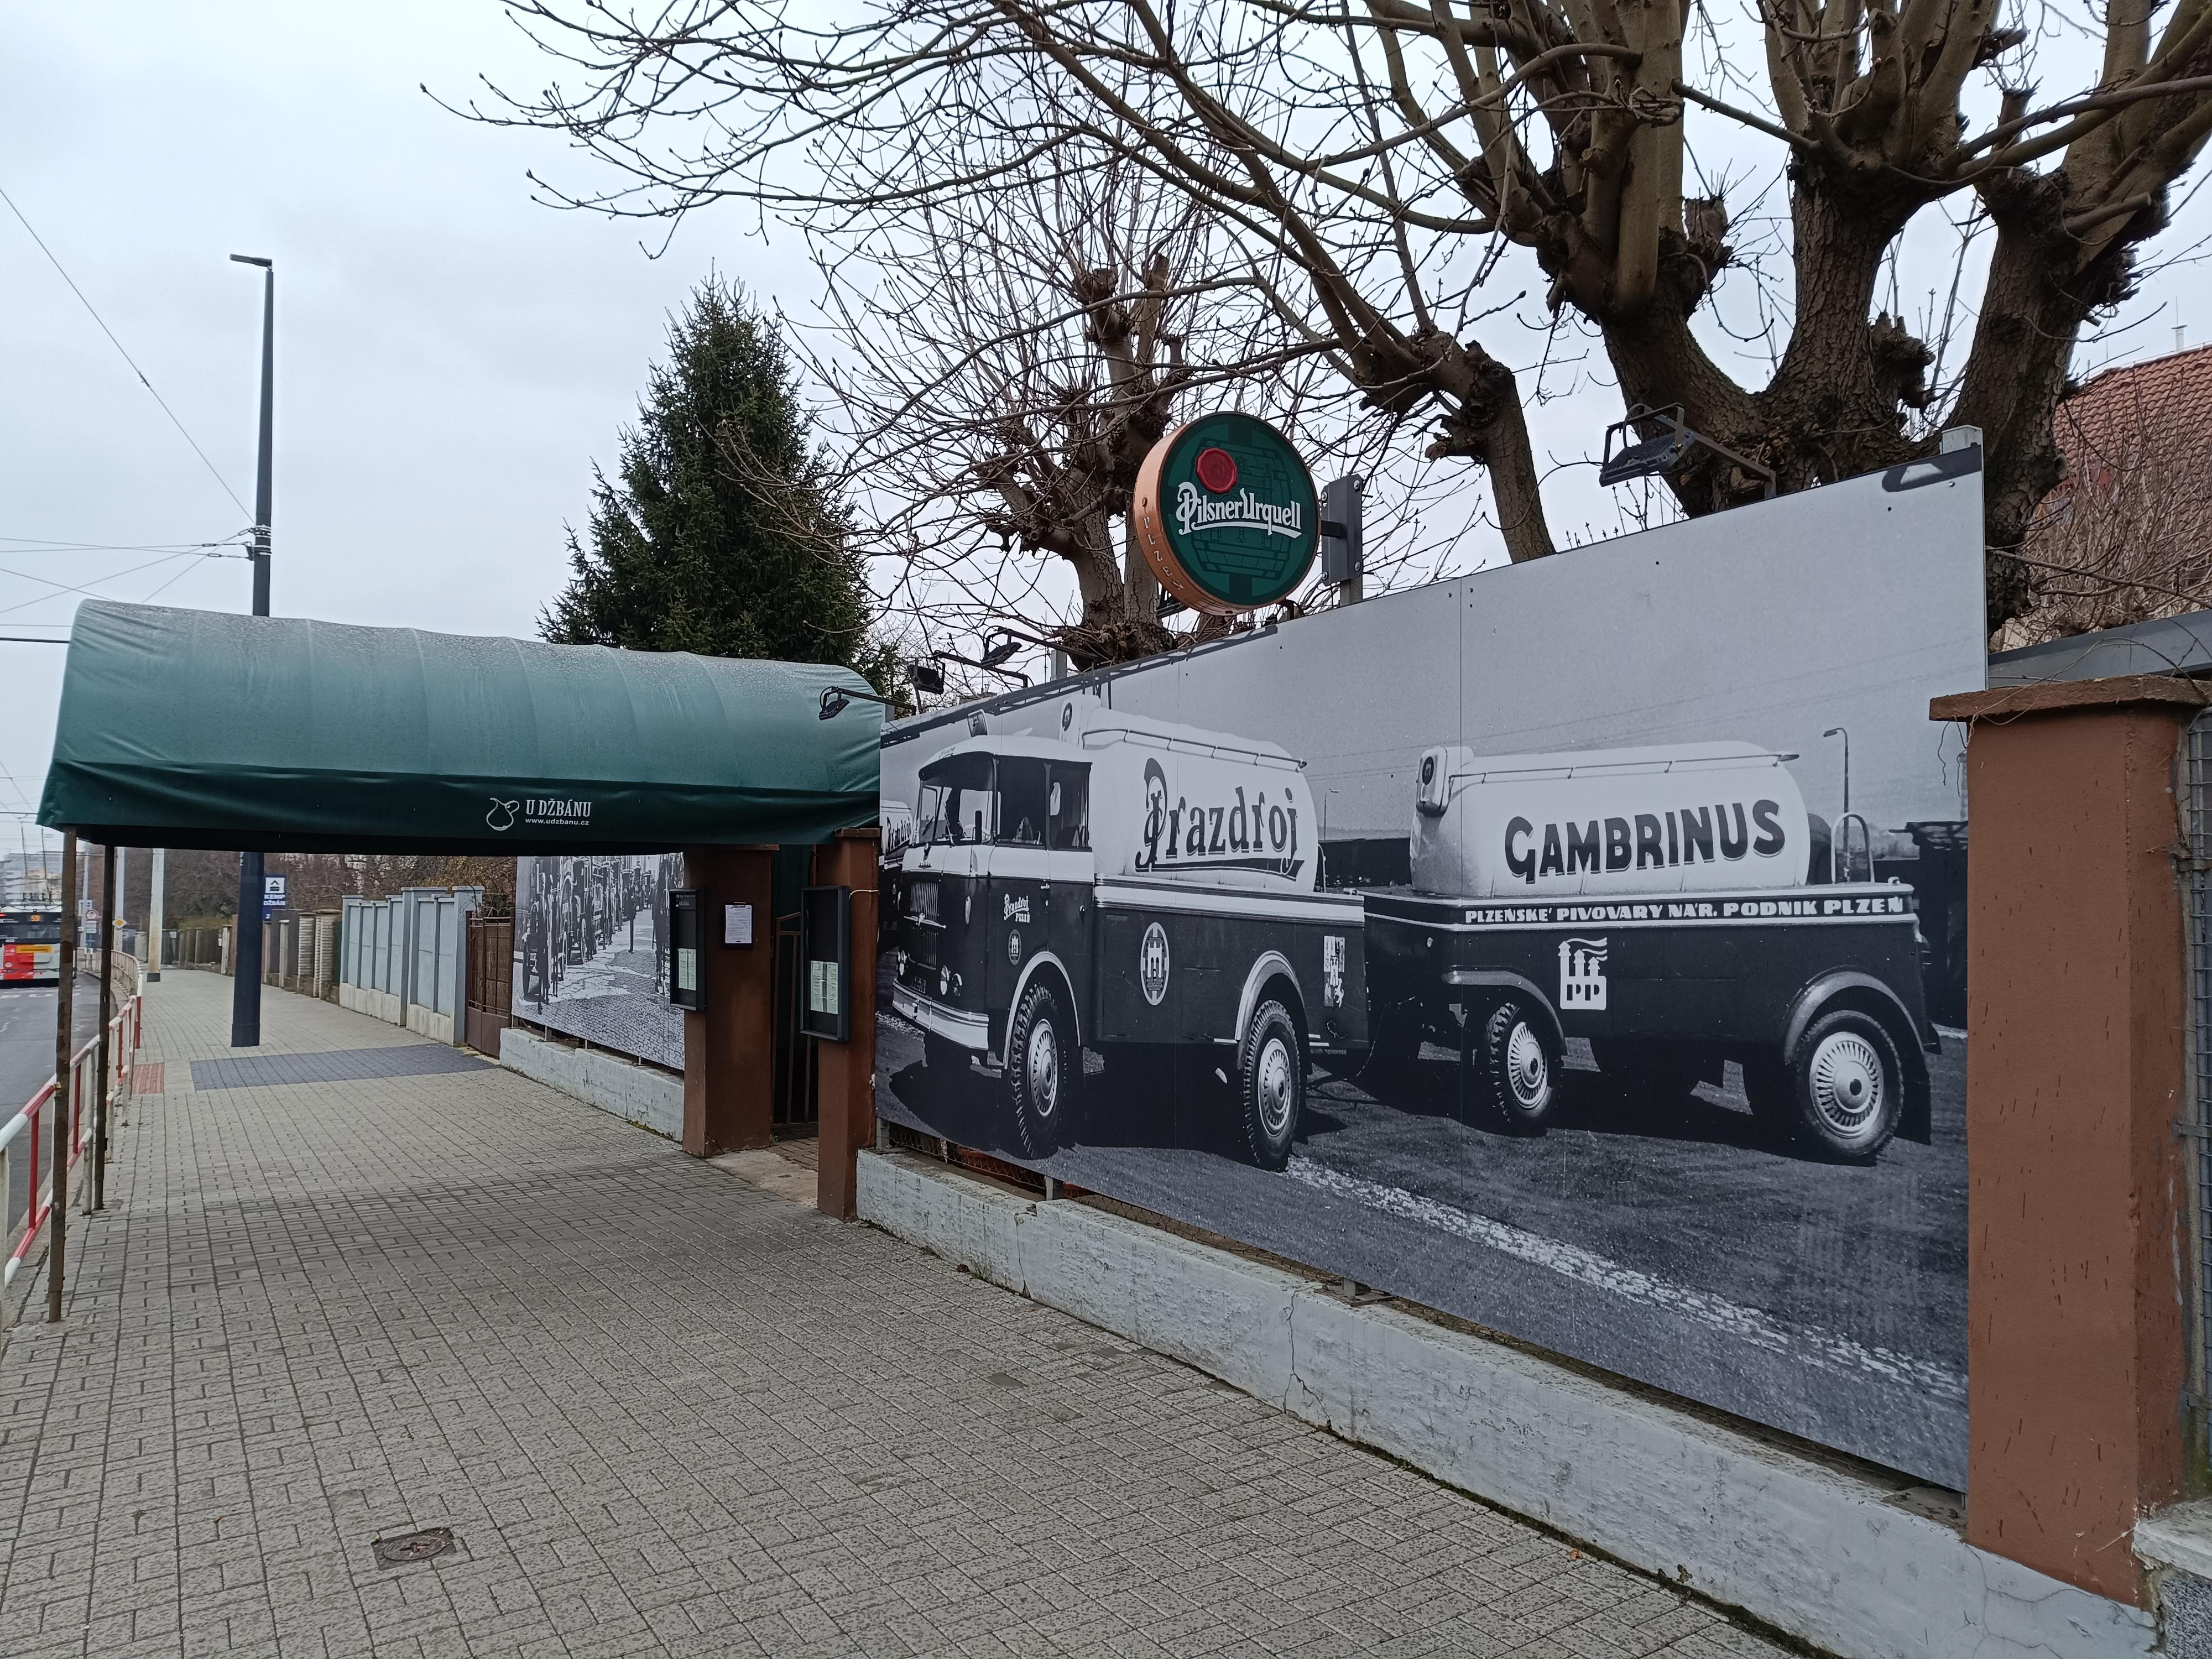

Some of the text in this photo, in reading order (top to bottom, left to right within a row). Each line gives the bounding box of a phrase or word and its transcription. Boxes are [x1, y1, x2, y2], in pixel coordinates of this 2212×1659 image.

[1176, 481, 1301, 535] Pilsner Urquell
[526, 798, 592, 817] U DŽBÁNU
[1135, 758, 1303, 879] Prazdroj
[1505, 799, 1786, 884] GAMBRINUS
[1004, 894, 1029, 920] Prazdroj
[1557, 905, 1663, 921] PIVOVARY
[1723, 900, 1818, 916] PODNIK
